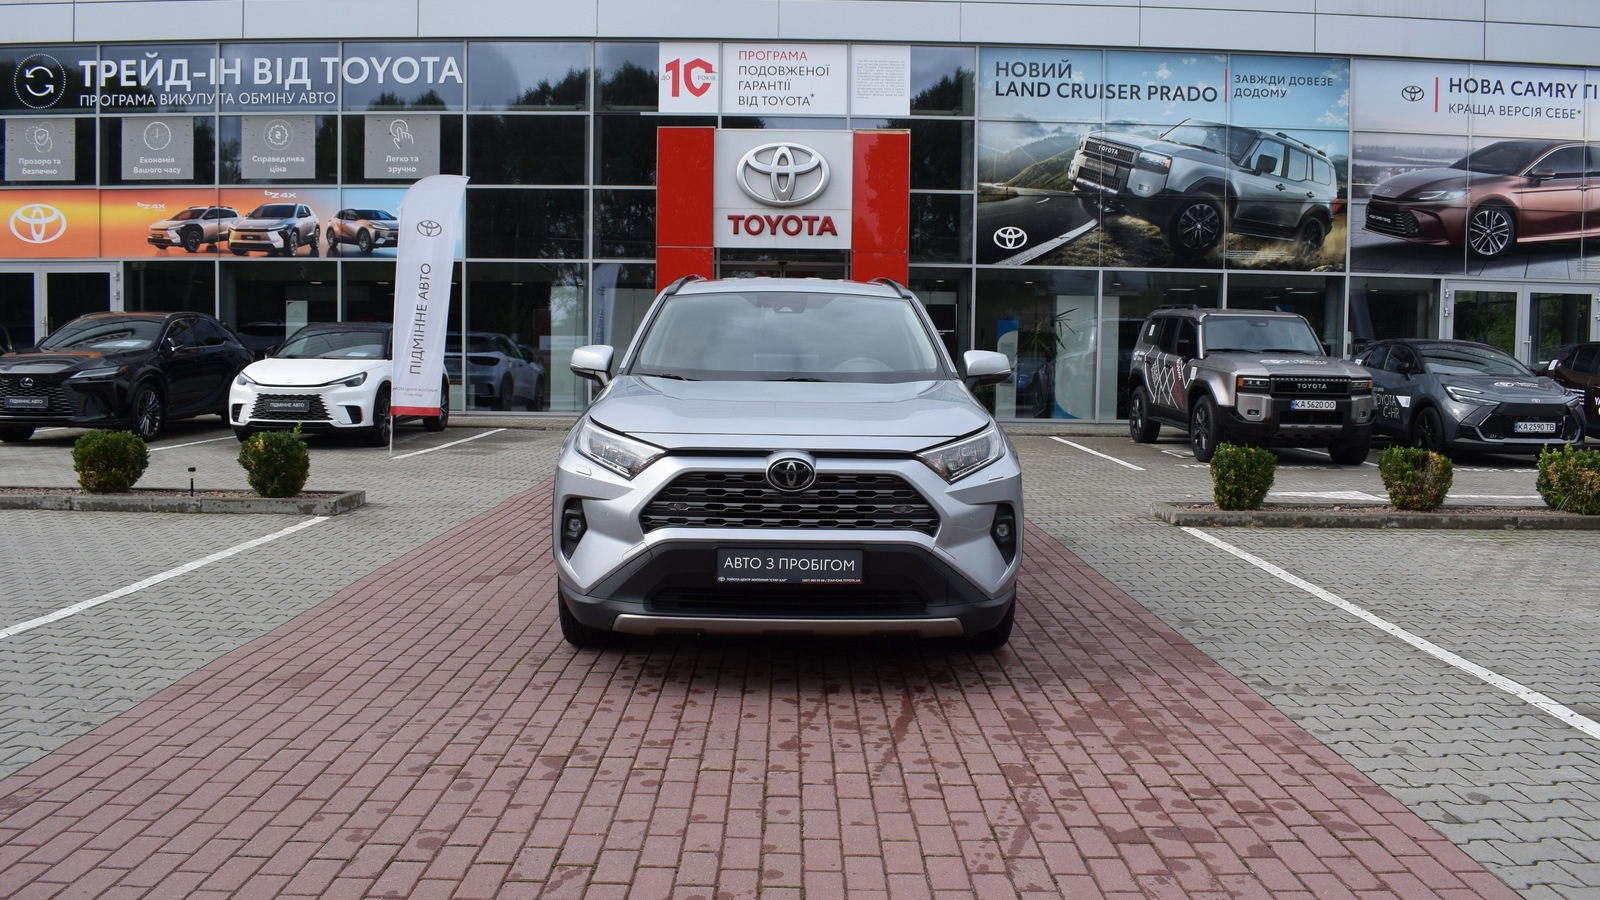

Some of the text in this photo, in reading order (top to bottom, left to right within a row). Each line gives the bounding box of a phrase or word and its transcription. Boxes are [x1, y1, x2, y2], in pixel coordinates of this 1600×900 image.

[738, 50, 808, 61] ПРОГРАМА
[79, 52, 464, 92] ТРЕЙД-ІН ВІД TOYOTA
[738, 64, 831, 77] ПОДОВЖЕНОЇ
[995, 59, 1072, 79] НОВИЙ
[665, 58, 713, 97] 10
[1234, 74, 1333, 87] ЗАВЖДИ ДОВЕЗЕ
[738, 79, 792, 91] ГАРАНТІЇ
[1449, 77, 1505, 95] НОВА
[1510, 80, 1578, 99] CAMRY
[995, 81, 1218, 102] LAND CRUISER PRADO
[1233, 88, 1288, 99] ДОДОМУ
[80, 92, 336, 107] ПРОГРАМА ВИКУПУ ТА ОБМІНУ АВТО
[738, 96, 759, 107] ВІД
[1448, 103, 1495, 116] КРАЩА
[1499, 105, 1542, 117] ВЕРСІЯ
[18, 157, 62, 166] Прозоро та
[139, 156, 175, 164] Економія
[252, 155, 305, 163] Справедлива
[385, 155, 409, 163] Легко
[21, 167, 58, 175] безпечно
[133, 166, 181, 175] Вашого часу
[269, 165, 287, 173] ціна
[387, 166, 417, 174] зручно
[727, 214, 838, 237] TOYOTA
[409, 263, 432, 375] ПІДМІННЕ АВТО
[1307, 401, 1323, 409] 5620
[1375, 393, 1397, 407] OYOTA
[723, 556, 855, 572] АВТО З ПРОБІГОМ
